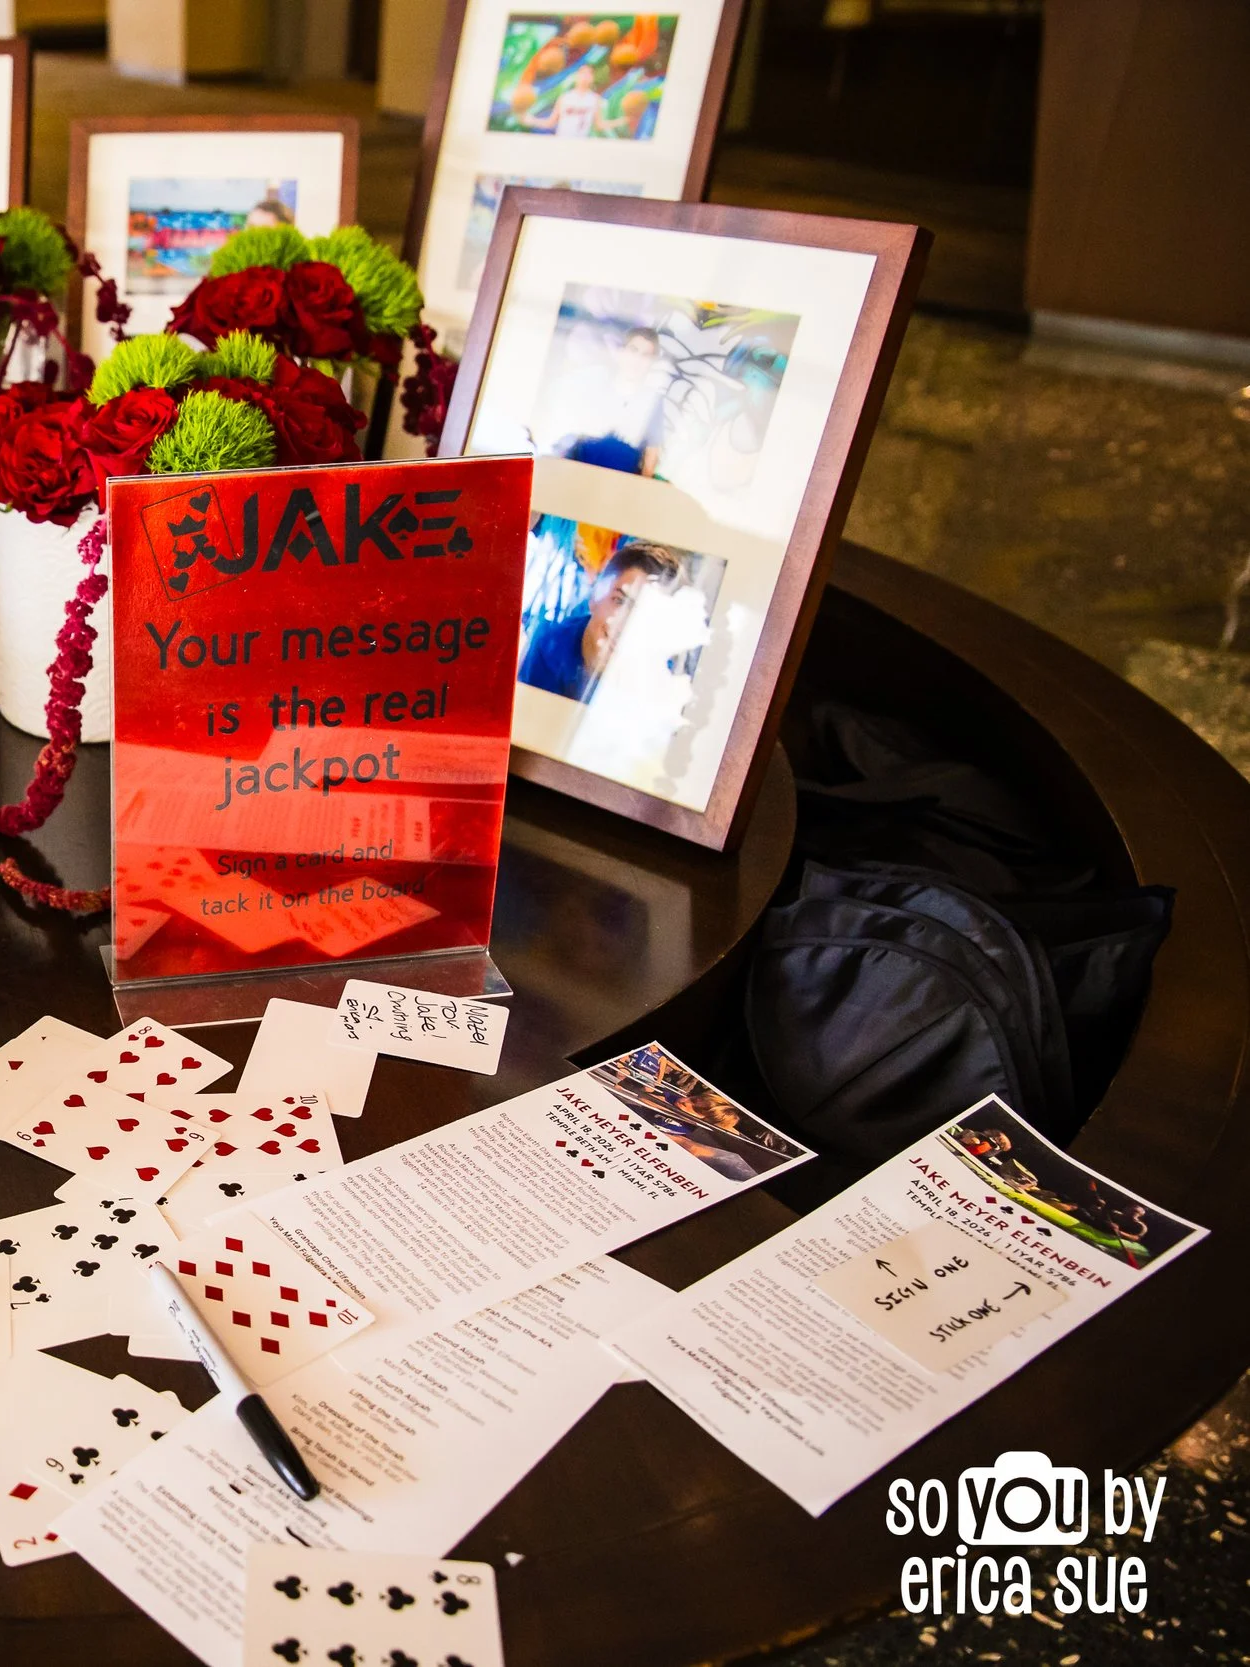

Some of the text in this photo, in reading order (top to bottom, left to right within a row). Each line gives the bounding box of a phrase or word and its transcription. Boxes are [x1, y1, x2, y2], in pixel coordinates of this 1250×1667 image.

[211, 483, 472, 576] JAKE
[145, 616, 491, 670] Your message
[207, 682, 449, 736] is the real
[215, 743, 401, 811] jackpot
[217, 839, 393, 879] Sign a card and
[201, 877, 425, 917] tack it on the board
[138, 1025, 152, 1035] 8
[461, 1003, 490, 1046] Mazel
[299, 1094, 319, 1105] 10
[545, 1111, 576, 1136] TEMPLE
[574, 1135, 598, 1152] BETH
[595, 1153, 612, 1164] AM
[647, 1190, 658, 1199] FL
[552, 1104, 580, 1125] APRIL
[591, 1134, 616, 1152] 2026
[628, 1162, 654, 1180] IYAR
[652, 1179, 676, 1196] 5786
[555, 1087, 708, 1198] JAKE MEYER ELFENBEIN
[269, 1216, 284, 1231] Yeya
[282, 1230, 300, 1248] Marta
[908, 1157, 950, 1190] JAKE
[949, 1191, 1008, 1230] MEYER
[1010, 1230, 1110, 1287] ELFENBEIN
[910, 1179, 942, 1207] APRIL
[961, 1217, 990, 1236] 2026
[1013, 1248, 1044, 1268] IYAR
[1046, 1267, 1075, 1286] 5786
[294, 1228, 365, 1299] Grancapa Chet Elfenbein
[875, 1256, 969, 1311] SIGN ONE
[337, 1307, 359, 1326] 10
[929, 1298, 1001, 1343] STICK ONE
[13, 1537, 38, 1549] 2
[456, 1574, 481, 1585] 8
